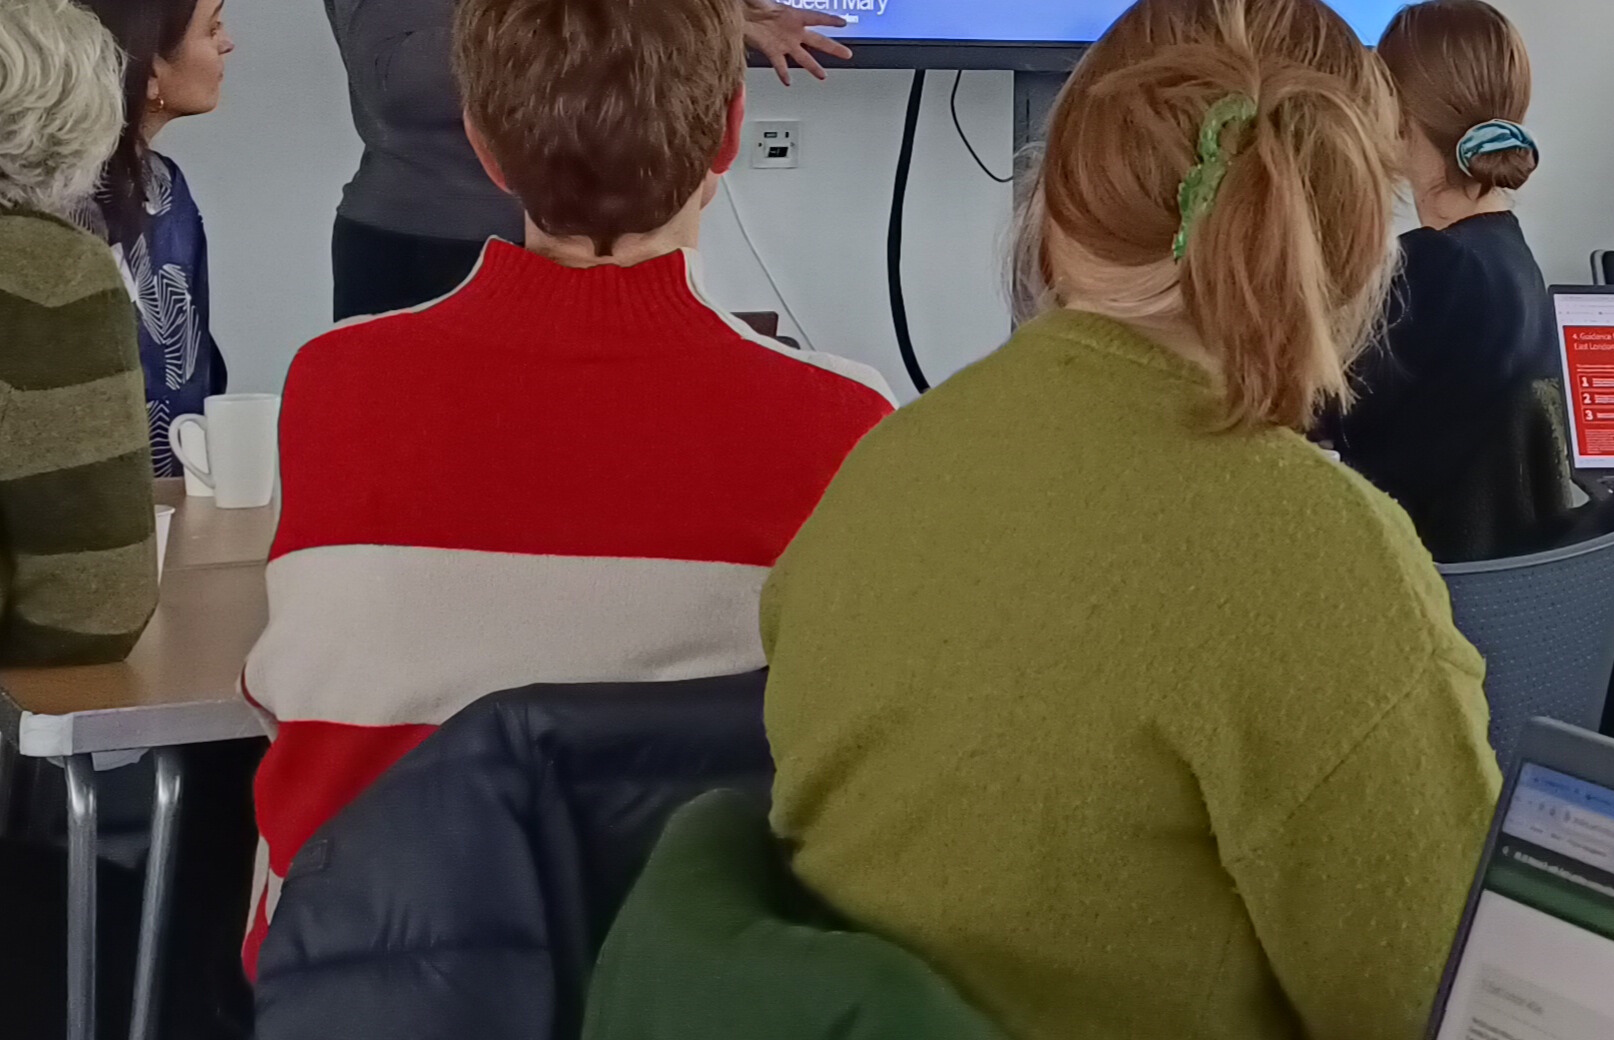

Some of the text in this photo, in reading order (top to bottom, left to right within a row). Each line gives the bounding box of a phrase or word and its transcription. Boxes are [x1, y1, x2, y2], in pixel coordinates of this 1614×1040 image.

[1582, 377, 1589, 387] 1
[1583, 393, 1592, 404] 2
[1585, 410, 1594, 420] 3
